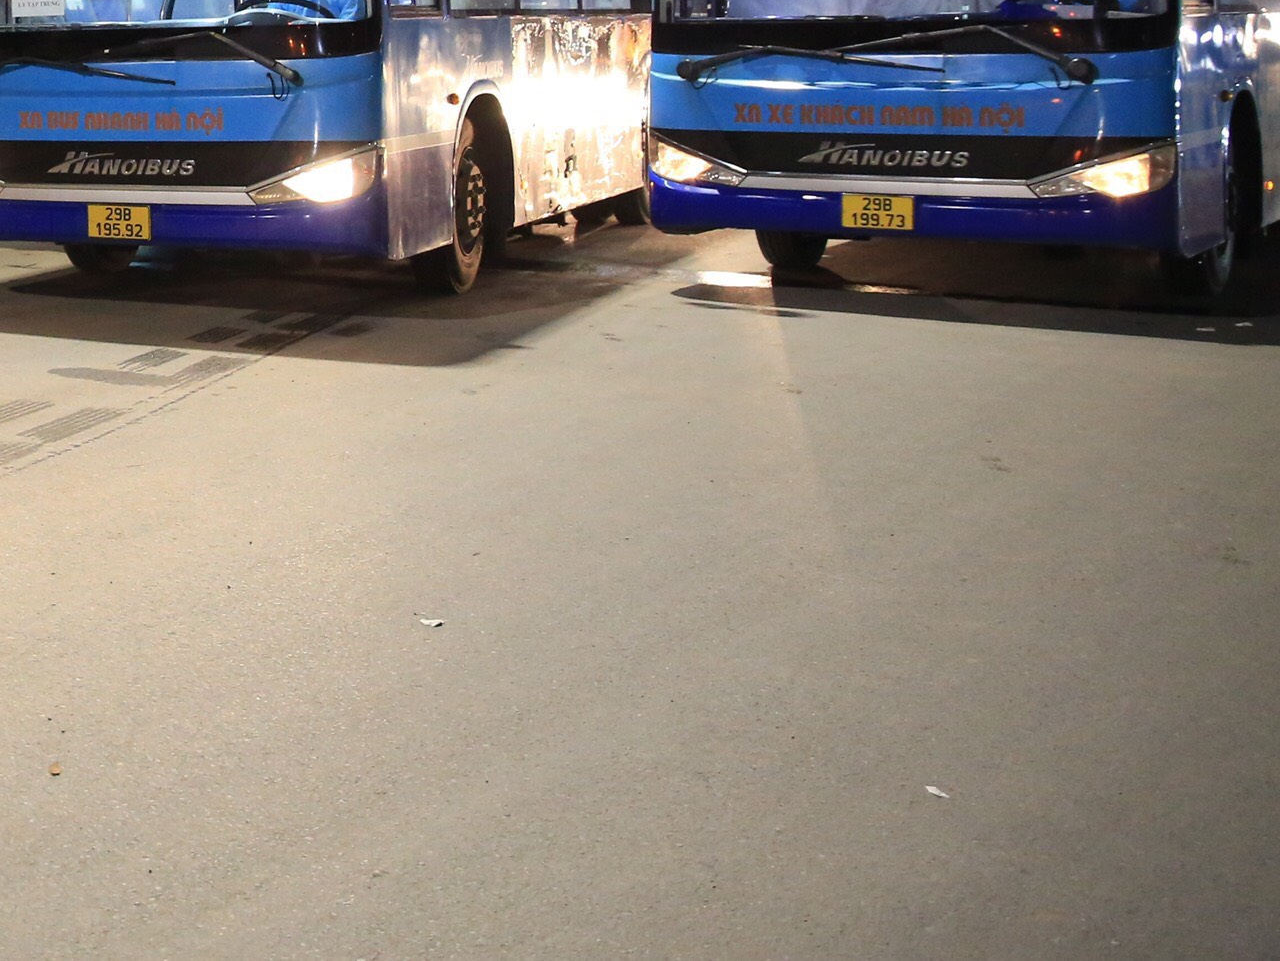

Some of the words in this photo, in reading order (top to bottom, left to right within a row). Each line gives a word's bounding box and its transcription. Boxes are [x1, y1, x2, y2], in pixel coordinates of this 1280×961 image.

[47, 111, 80, 130] BUS
[85, 112, 150, 131] NHANH
[155, 107, 181, 131] HÀ
[186, 106, 224, 136] NỘI
[768, 104, 793, 124] XE
[801, 98, 875, 125] KHÁCH
[880, 106, 934, 126] NAM
[942, 101, 974, 127] HÀ
[979, 102, 1026, 134] NỘI
[47, 151, 196, 176] HANOIBUS
[798, 140, 970, 168] HANOIBUS
[105, 207, 131, 221] 29B
[862, 197, 892, 212] 29B
[95, 222, 143, 238] 195.92
[851, 212, 906, 228] 199.73
